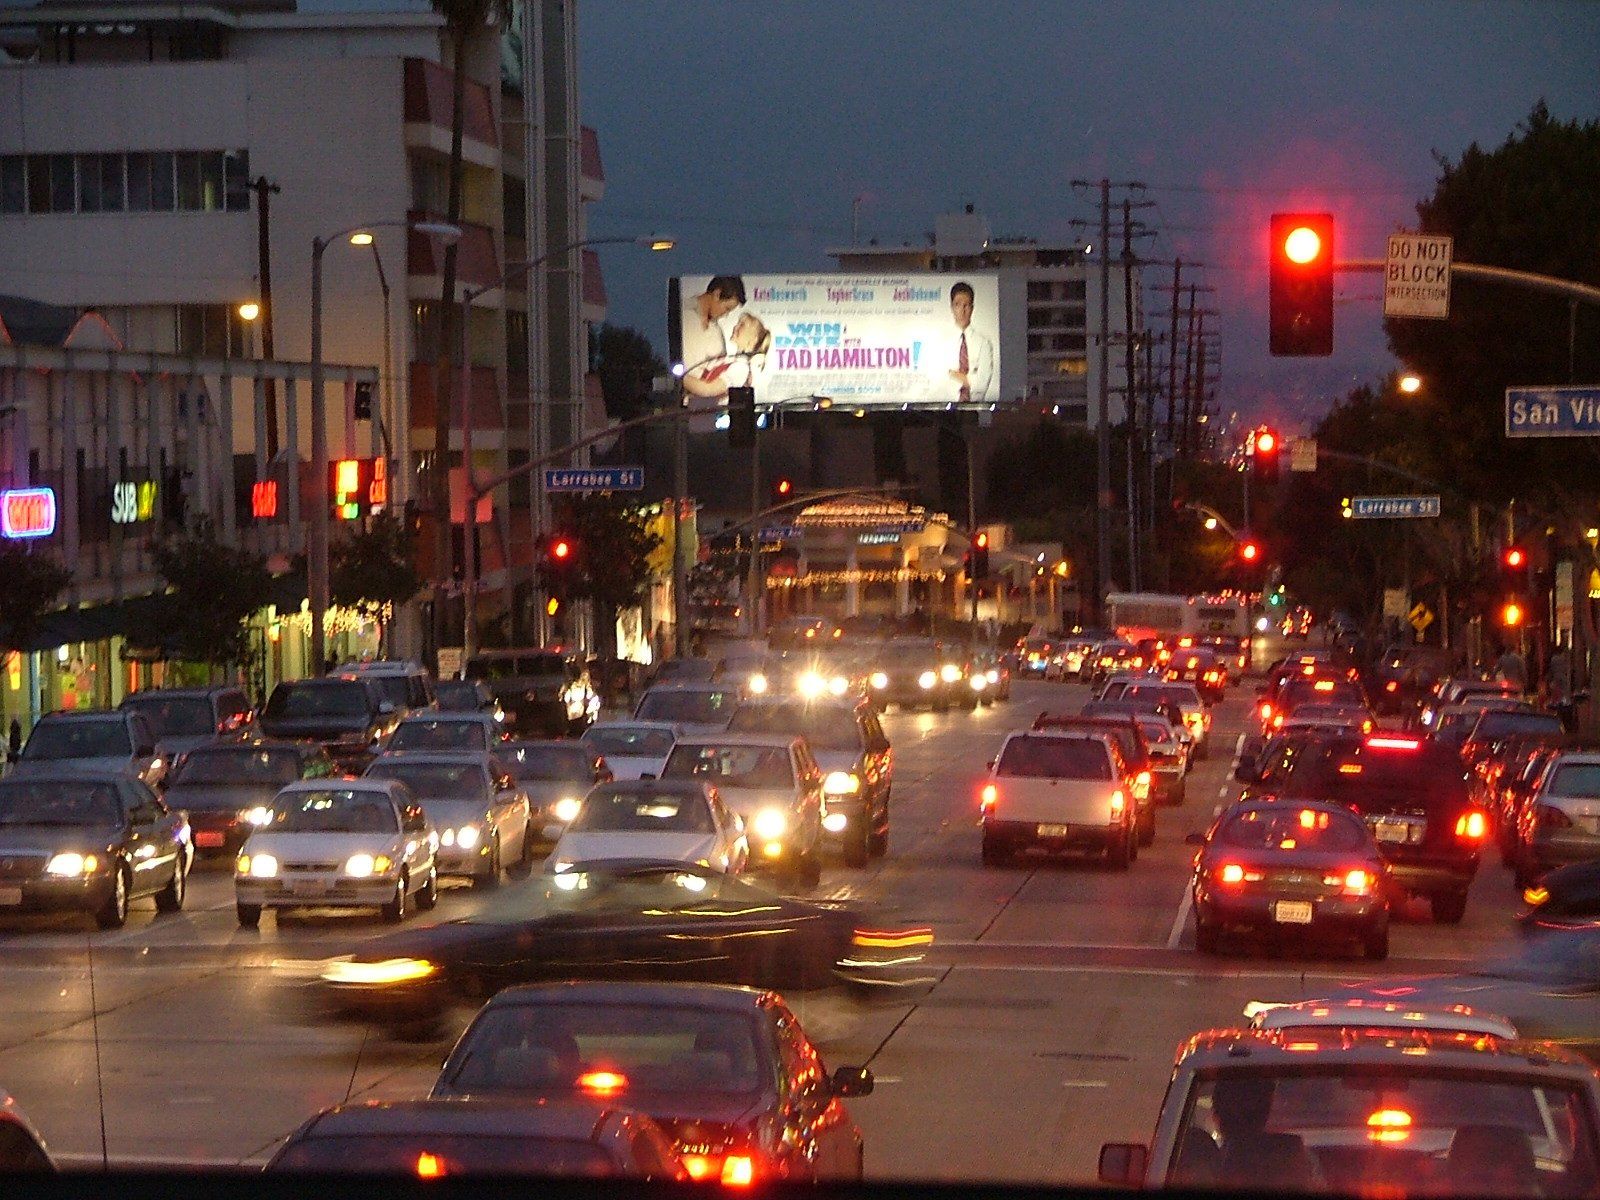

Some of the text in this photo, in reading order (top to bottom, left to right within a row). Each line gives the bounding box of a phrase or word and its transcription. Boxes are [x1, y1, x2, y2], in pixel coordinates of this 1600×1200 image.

[1390, 241, 1447, 260] DO NOT
[1389, 264, 1446, 283] BLOCK
[788, 323, 841, 335] WIN
[775, 335, 841, 346] DATE
[776, 348, 813, 370] TAD
[1513, 400, 1559, 425] San
